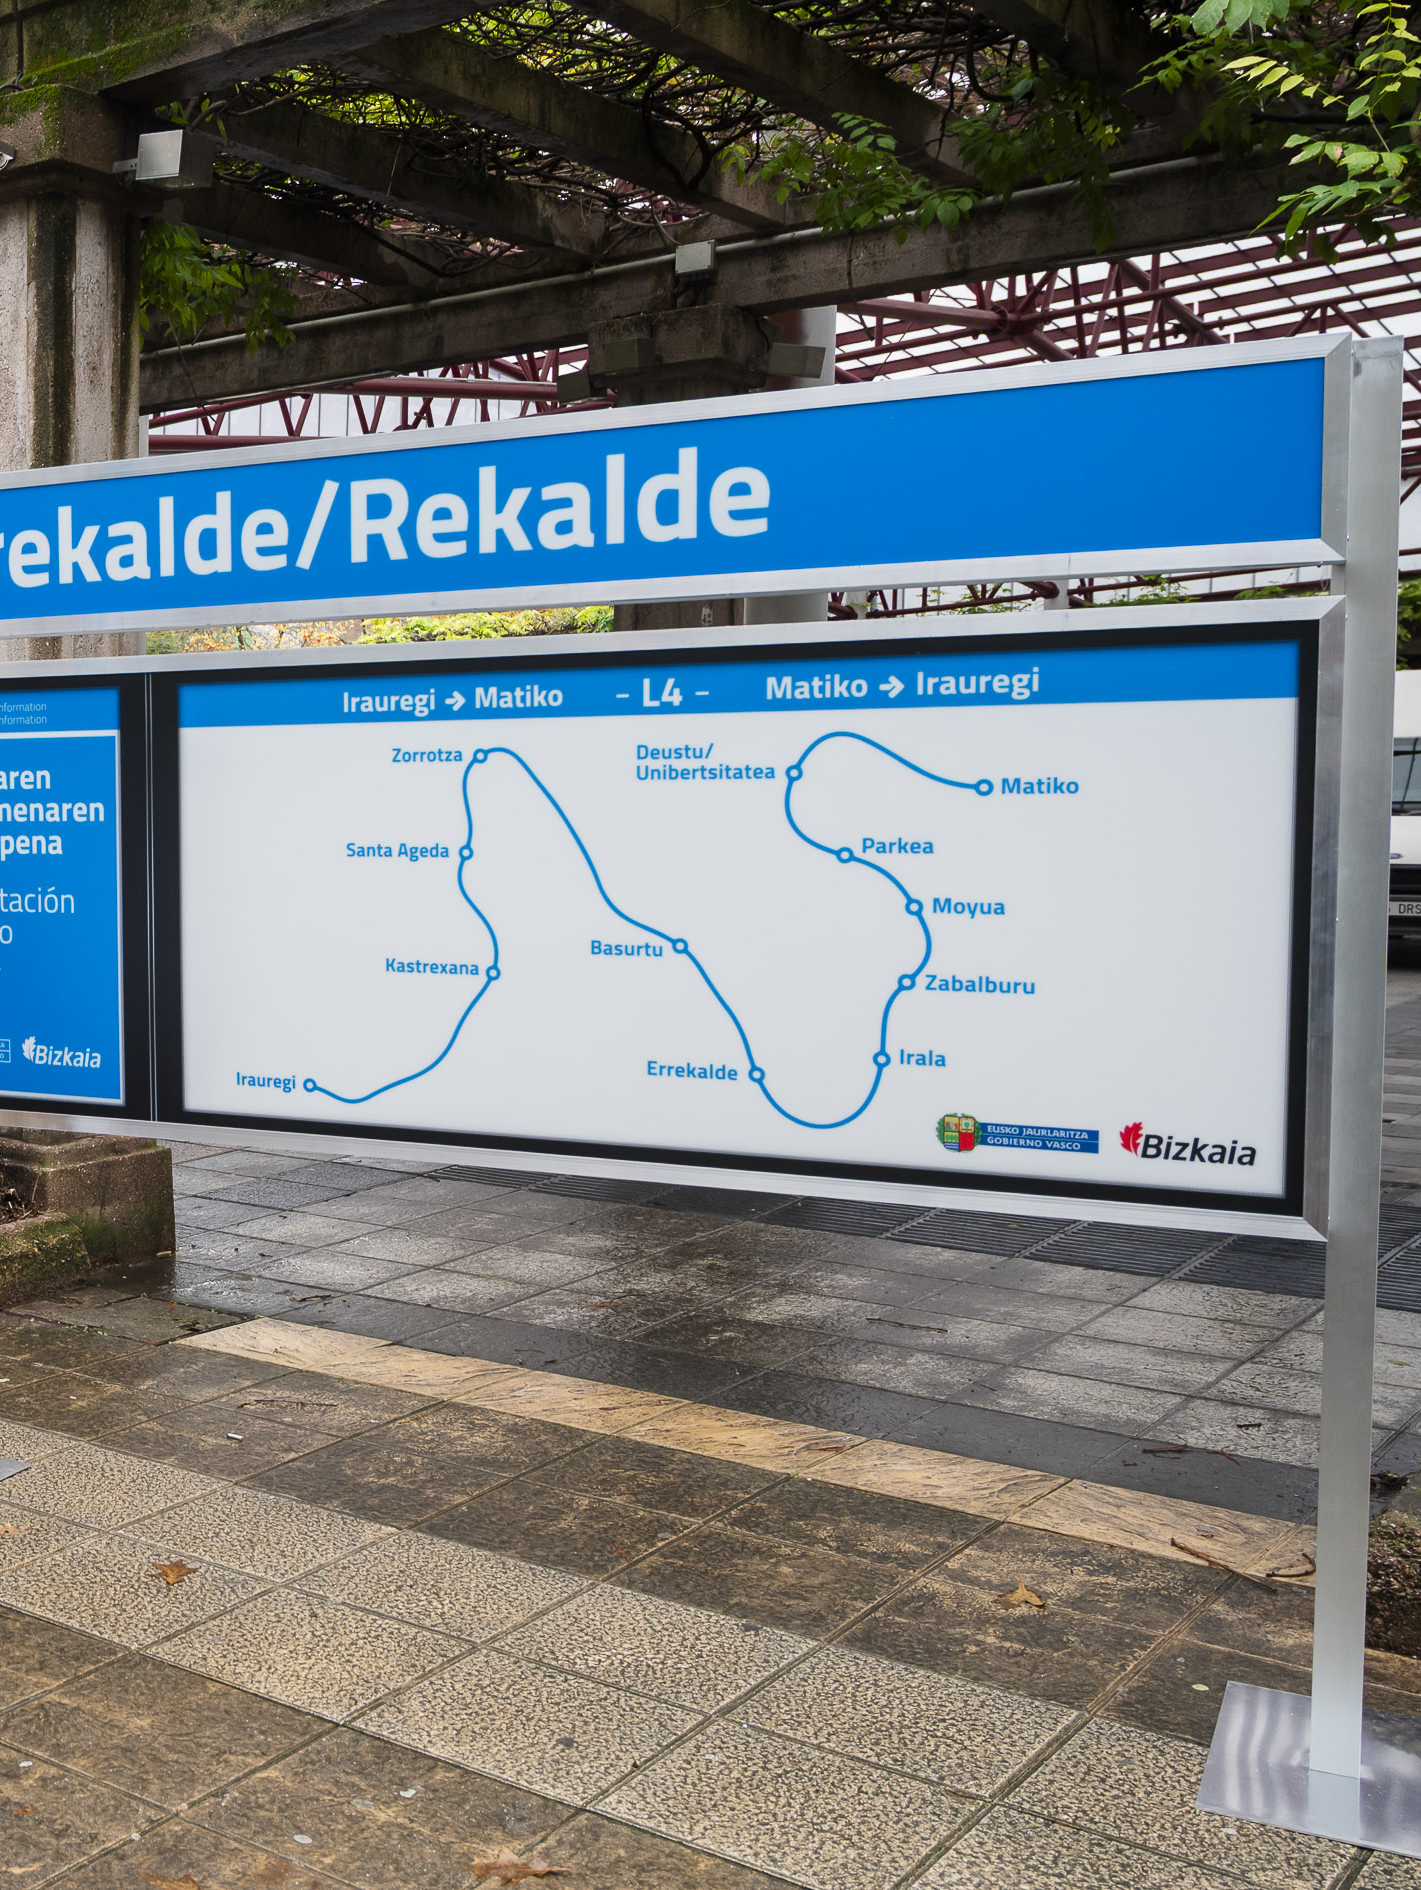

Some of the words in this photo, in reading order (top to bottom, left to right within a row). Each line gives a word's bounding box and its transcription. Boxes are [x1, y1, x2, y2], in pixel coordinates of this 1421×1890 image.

[344, 688, 435, 717] Irauregi
[476, 685, 563, 708] Matiko
[643, 678, 682, 707] L4
[767, 674, 868, 699] Matiko
[917, 667, 1039, 700] Irauregi
[392, 749, 462, 762] Zorrotza
[637, 743, 713, 759] Deustu/
[637, 764, 775, 780] Unibertsitatea
[1002, 777, 1079, 794] Matiko
[347, 843, 392, 857] Santa
[398, 843, 449, 862] Ageda
[863, 838, 933, 854] Parkea
[933, 898, 1005, 919] Moyua
[591, 940, 664, 957] Basurtu
[386, 958, 479, 975] Kastrexana
[926, 975, 1034, 994] Zabalburu
[36, 1045, 101, 1068] Bizkaia
[900, 1049, 946, 1067] Irala
[648, 1061, 737, 1080] Errekalde
[237, 1072, 295, 1093] Irauregi
[987, 1125, 1020, 1135] EUSKO
[1022, 1127, 1089, 1140] JAURLARITZA
[987, 1136, 1043, 1150] GOBIERNO
[1046, 1138, 1081, 1150] VASCO
[1141, 1134, 1256, 1166] Bizkaia
